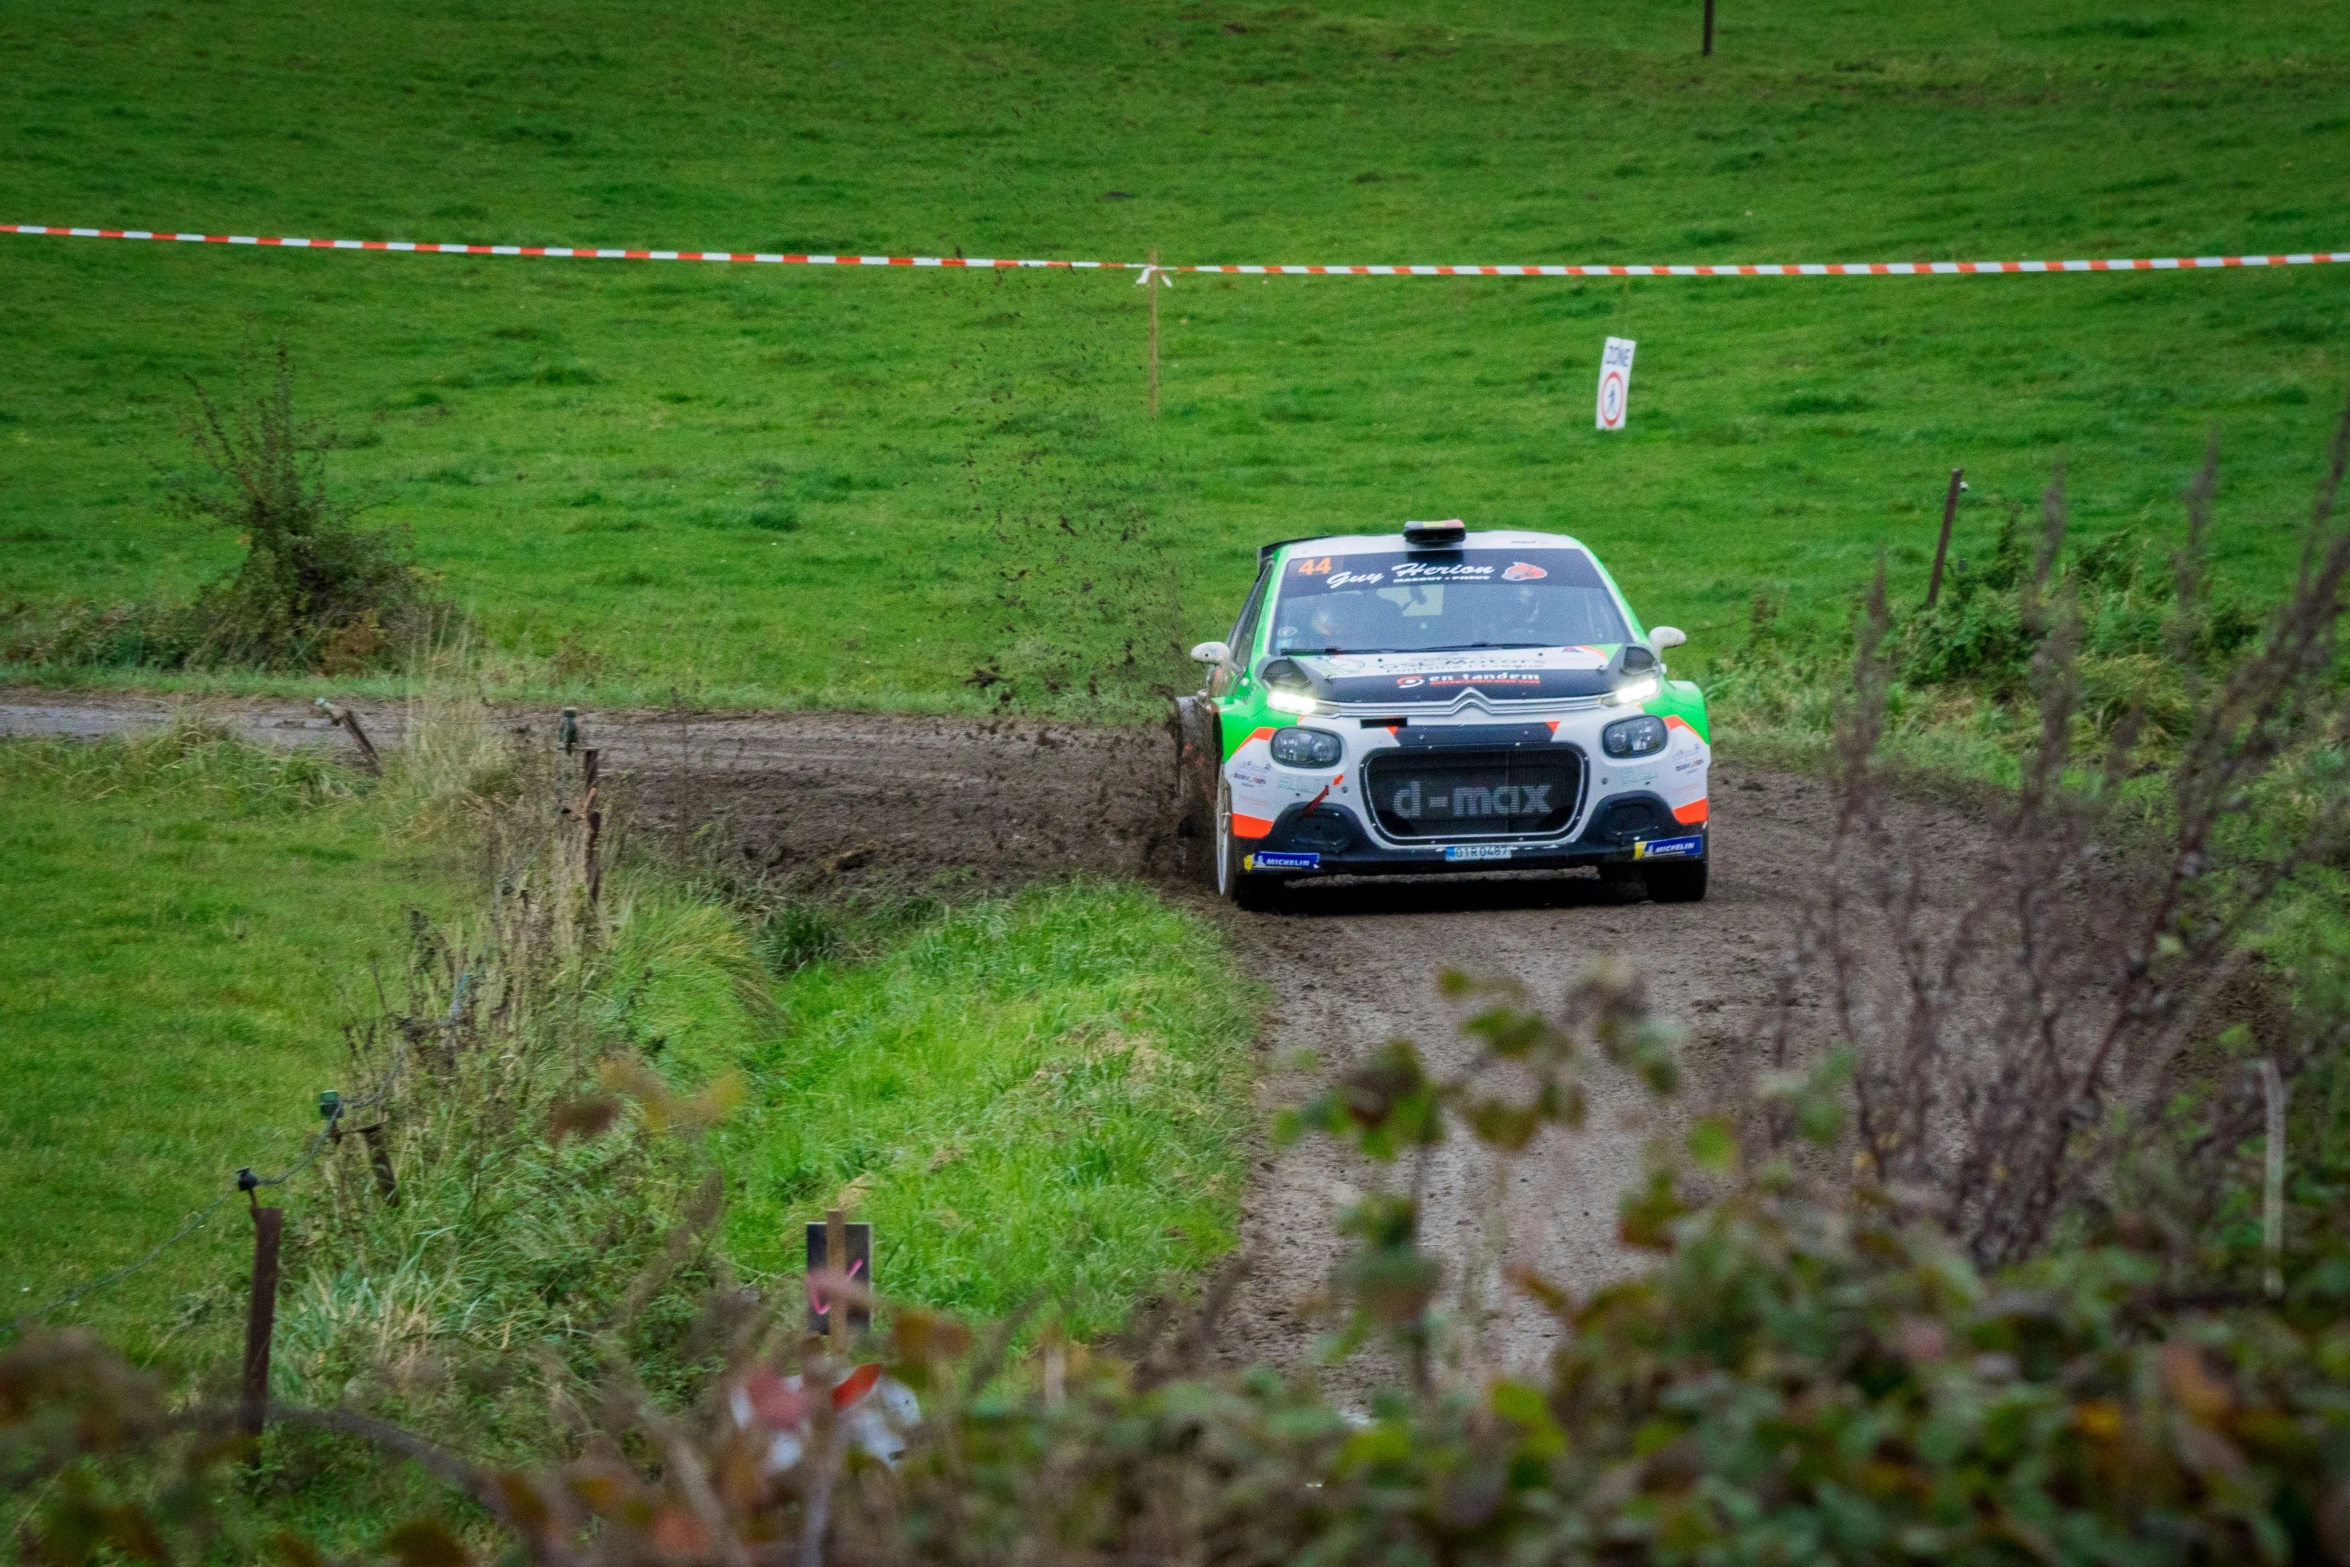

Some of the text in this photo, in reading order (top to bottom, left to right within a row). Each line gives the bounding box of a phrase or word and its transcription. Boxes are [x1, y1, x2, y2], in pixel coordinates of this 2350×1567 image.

[1298, 557, 1332, 576] 44
[1326, 562, 1496, 589] Guy Herion
[1462, 672, 1540, 680] tandem
[1392, 780, 1553, 819] d-max
[1655, 842, 1695, 852] MICHELIN
[1266, 858, 1310, 867] MICHELIN
